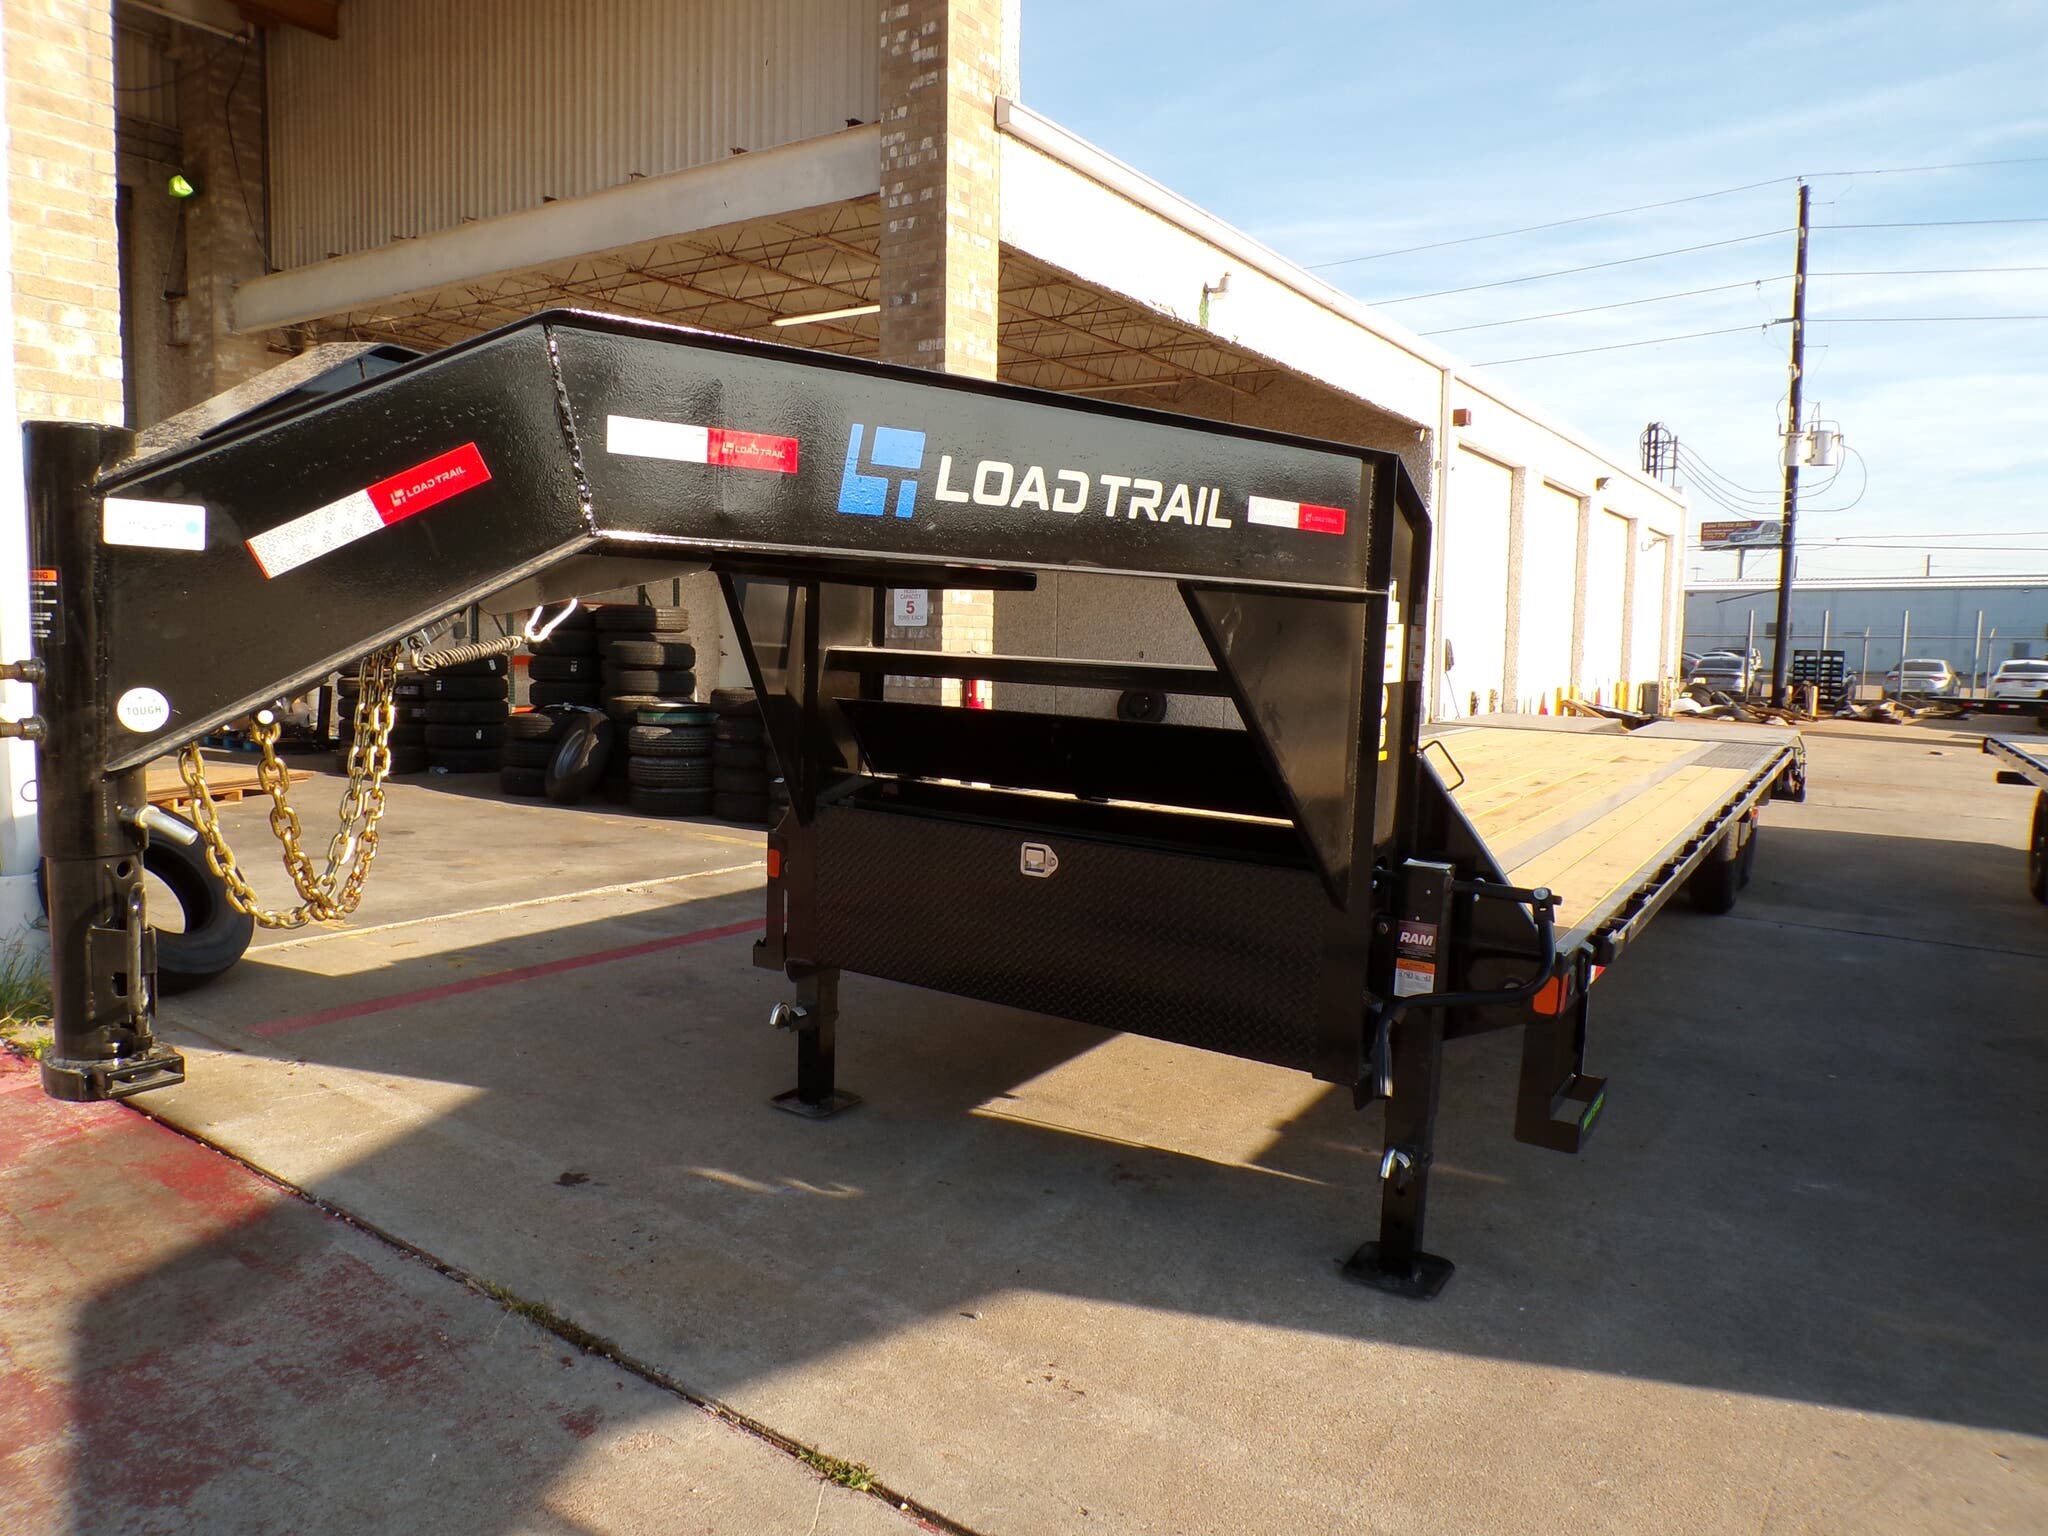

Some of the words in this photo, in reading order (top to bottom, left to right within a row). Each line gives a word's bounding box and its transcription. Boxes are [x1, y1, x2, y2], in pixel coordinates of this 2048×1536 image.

[734, 445, 760, 455] LOAD
[761, 449, 785, 459] TRAIL
[406, 478, 435, 498] LOAD
[435, 466, 466, 484] TRAIL
[935, 455, 1090, 514] LOAD
[1100, 474, 1232, 529] TRAIL
[906, 600, 915, 614] 5
[126, 705, 162, 716] TOUGH
[1400, 931, 1434, 946] RAM
